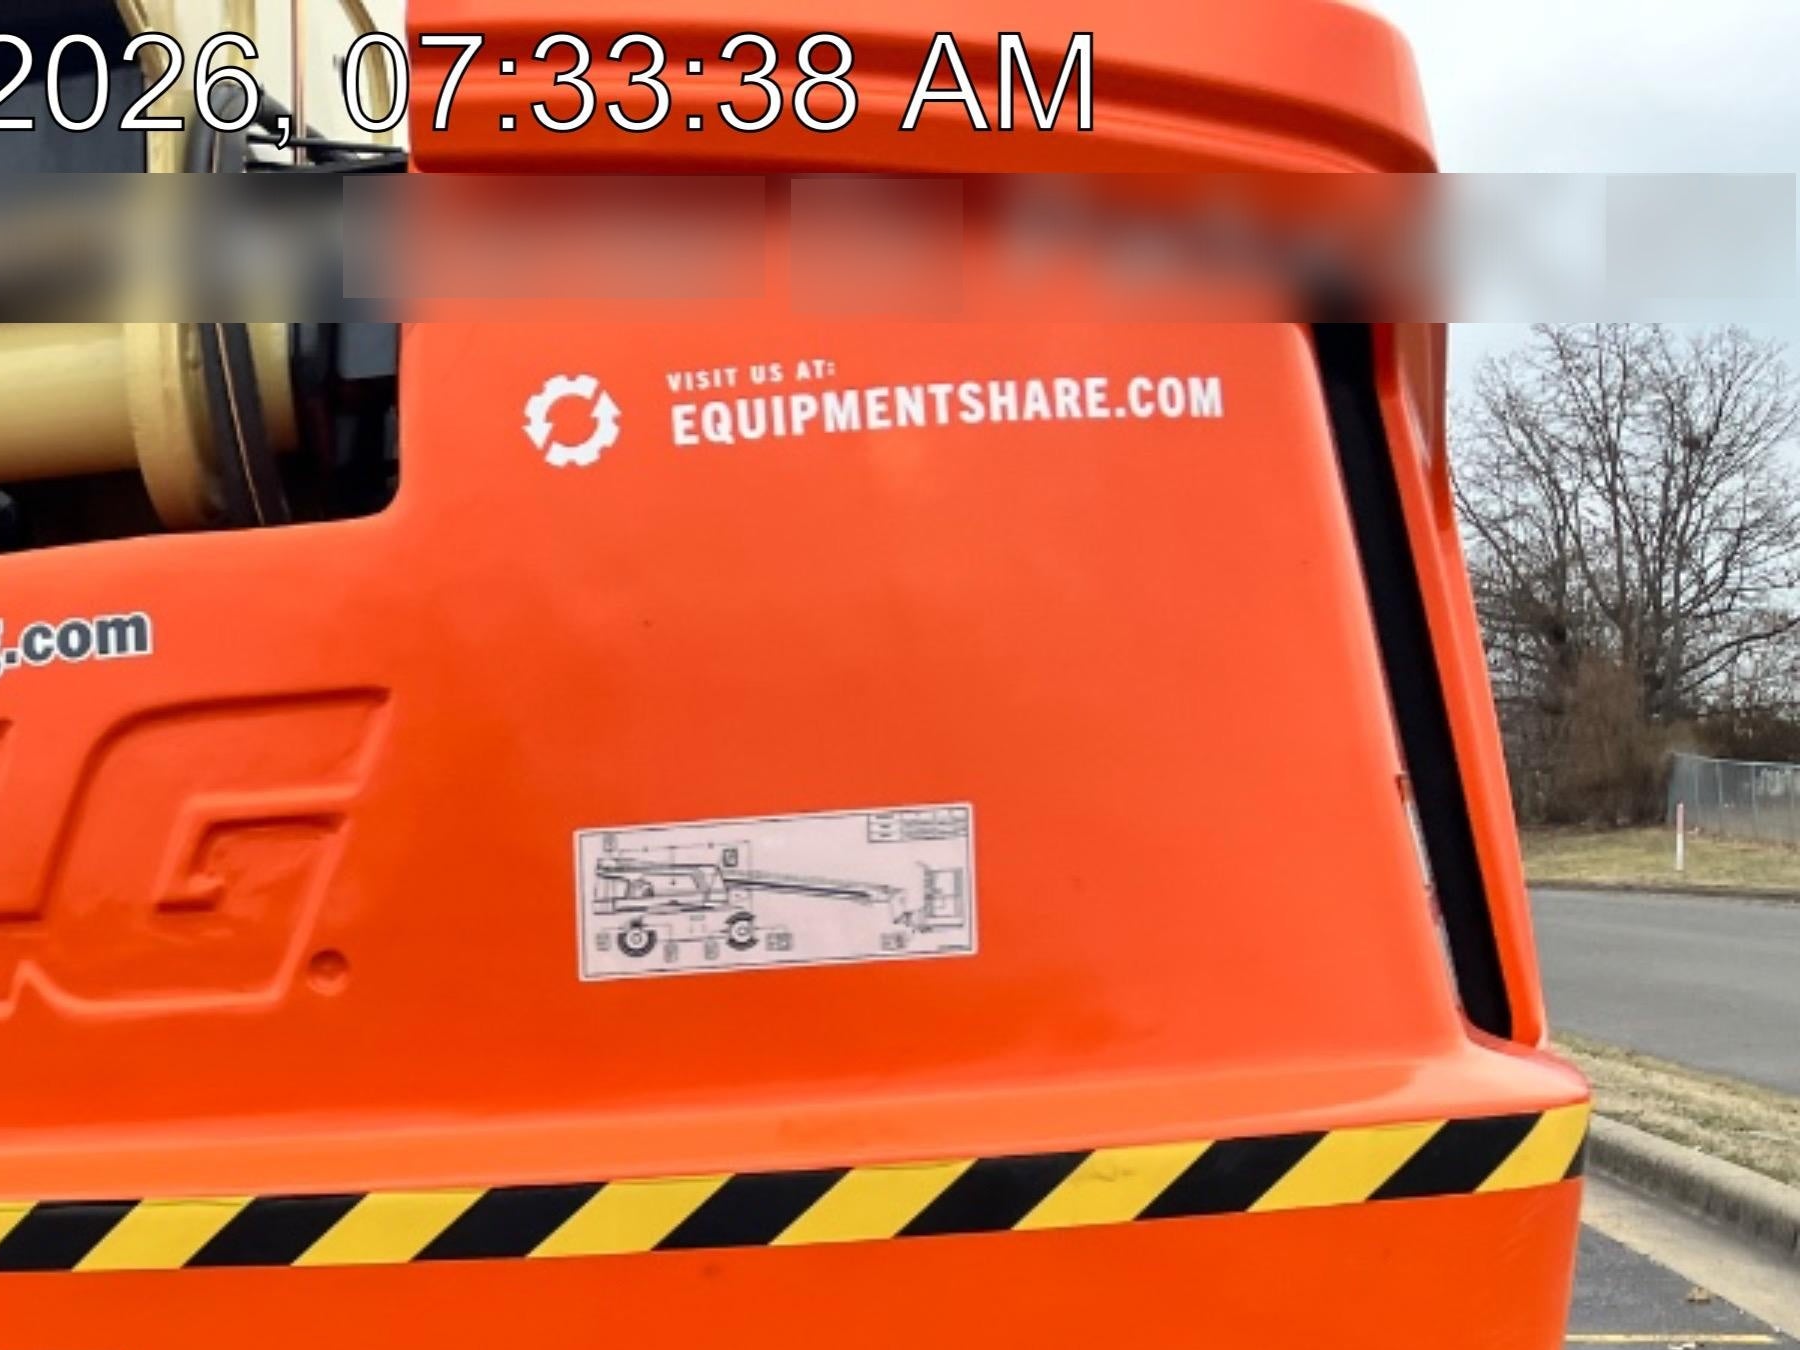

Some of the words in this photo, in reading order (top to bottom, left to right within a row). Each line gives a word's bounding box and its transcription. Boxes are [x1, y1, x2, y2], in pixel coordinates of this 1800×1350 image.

[666, 367, 738, 393] VISIT
[750, 362, 784, 385] US
[796, 359, 836, 382] AT:
[671, 375, 1224, 446] EQUIPMENTSHARE.COM
